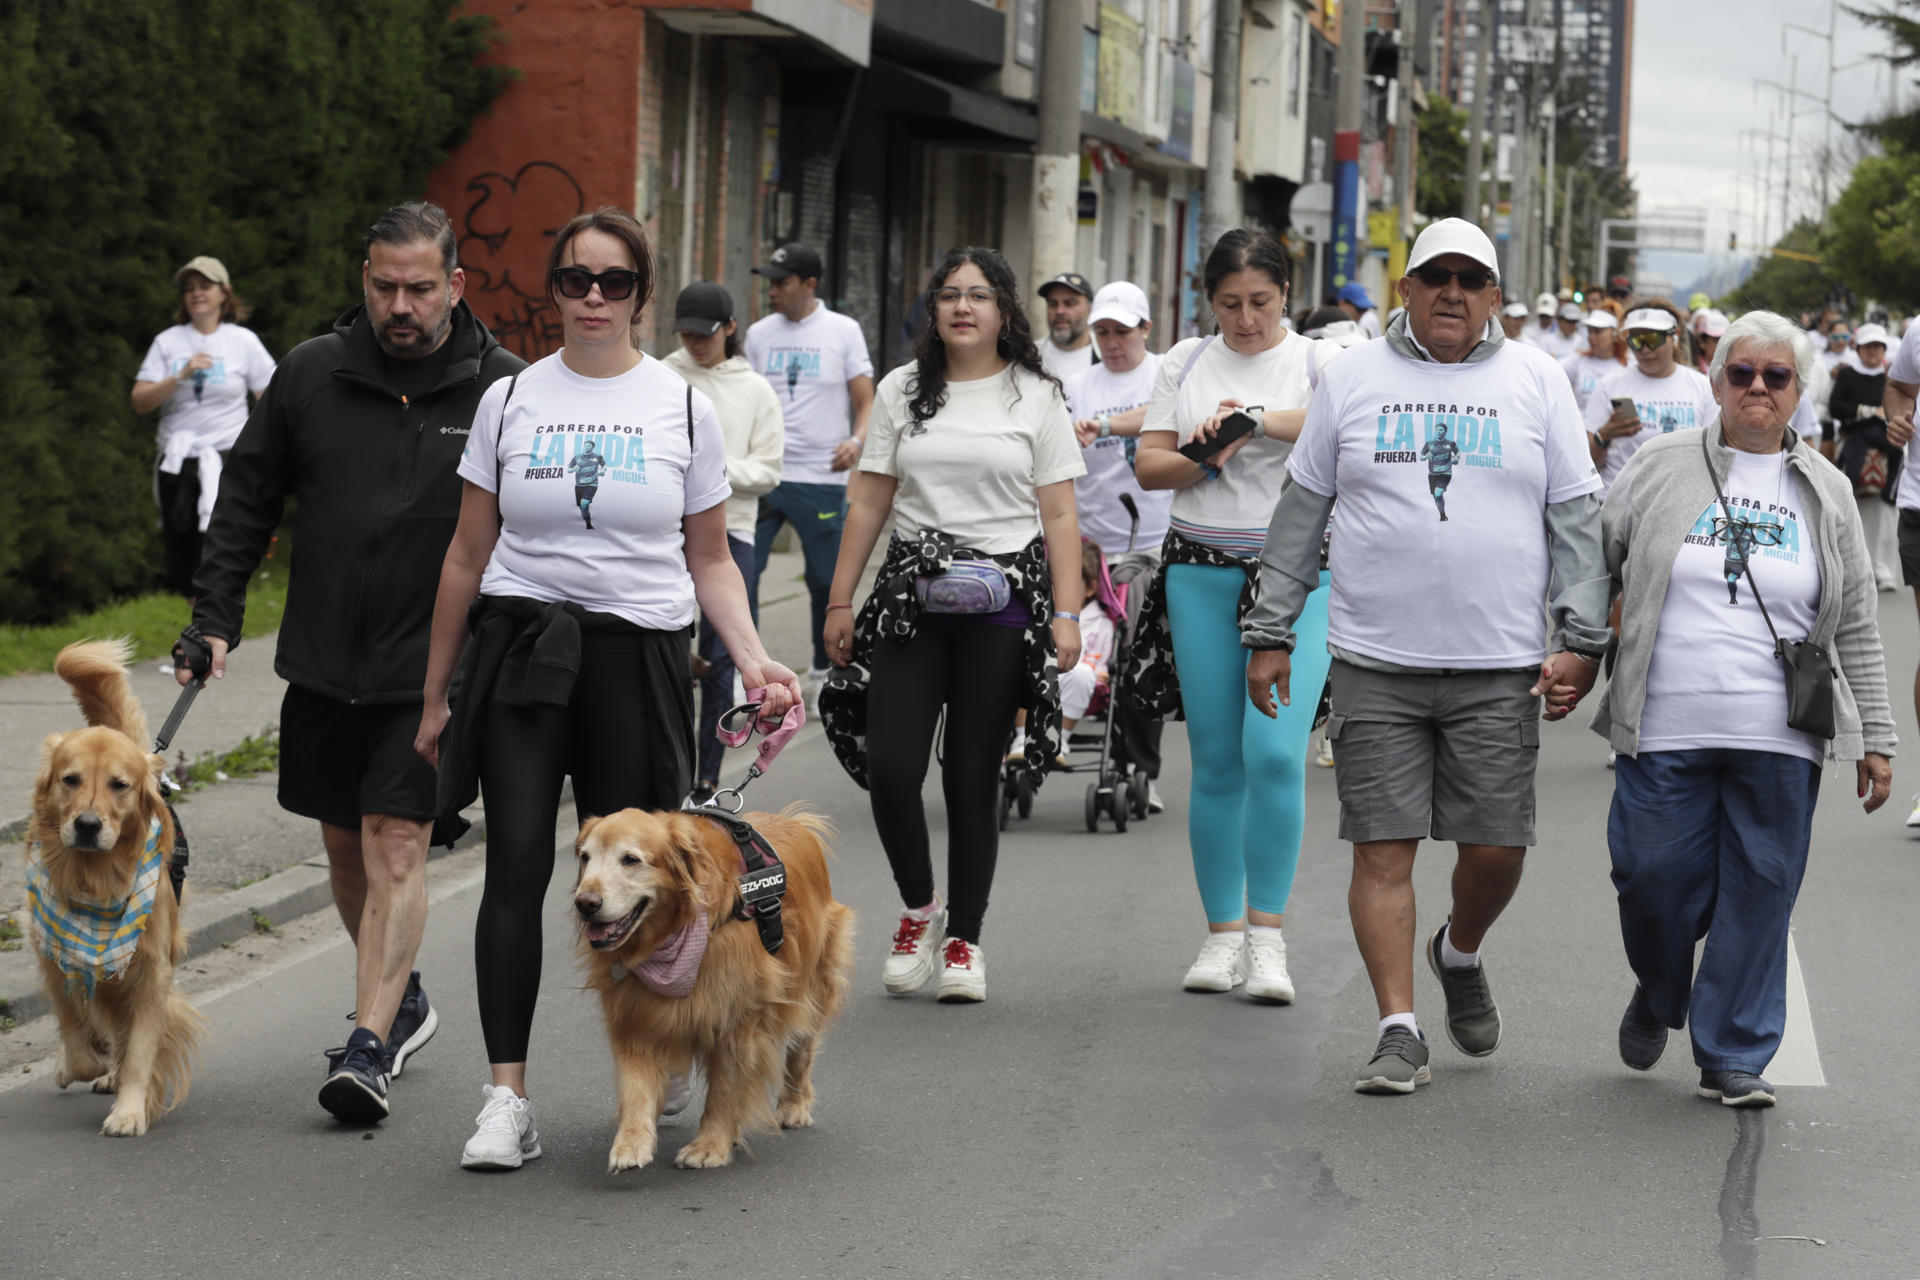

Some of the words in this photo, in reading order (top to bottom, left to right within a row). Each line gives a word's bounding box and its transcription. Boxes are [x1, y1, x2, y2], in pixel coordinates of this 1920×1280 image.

[1382, 403, 1458, 414] CARRERA
[1466, 406, 1498, 418] POR
[448, 427, 470, 436] Colum
[536, 424, 606, 434] CARRERA
[614, 424, 643, 436] POR
[1375, 413, 1415, 451] LA
[529, 434, 565, 467] LA
[1374, 451, 1417, 463] #FUERZA
[1465, 454, 1503, 469] MIGUEL
[524, 467, 564, 480] #FUERZA
[612, 469, 648, 485] MIGUEL
[1768, 504, 1797, 520] POR
[1684, 534, 1716, 547] UERZA
[1763, 547, 1800, 565] MIGUEL
[740, 873, 784, 894] EZYDOG
